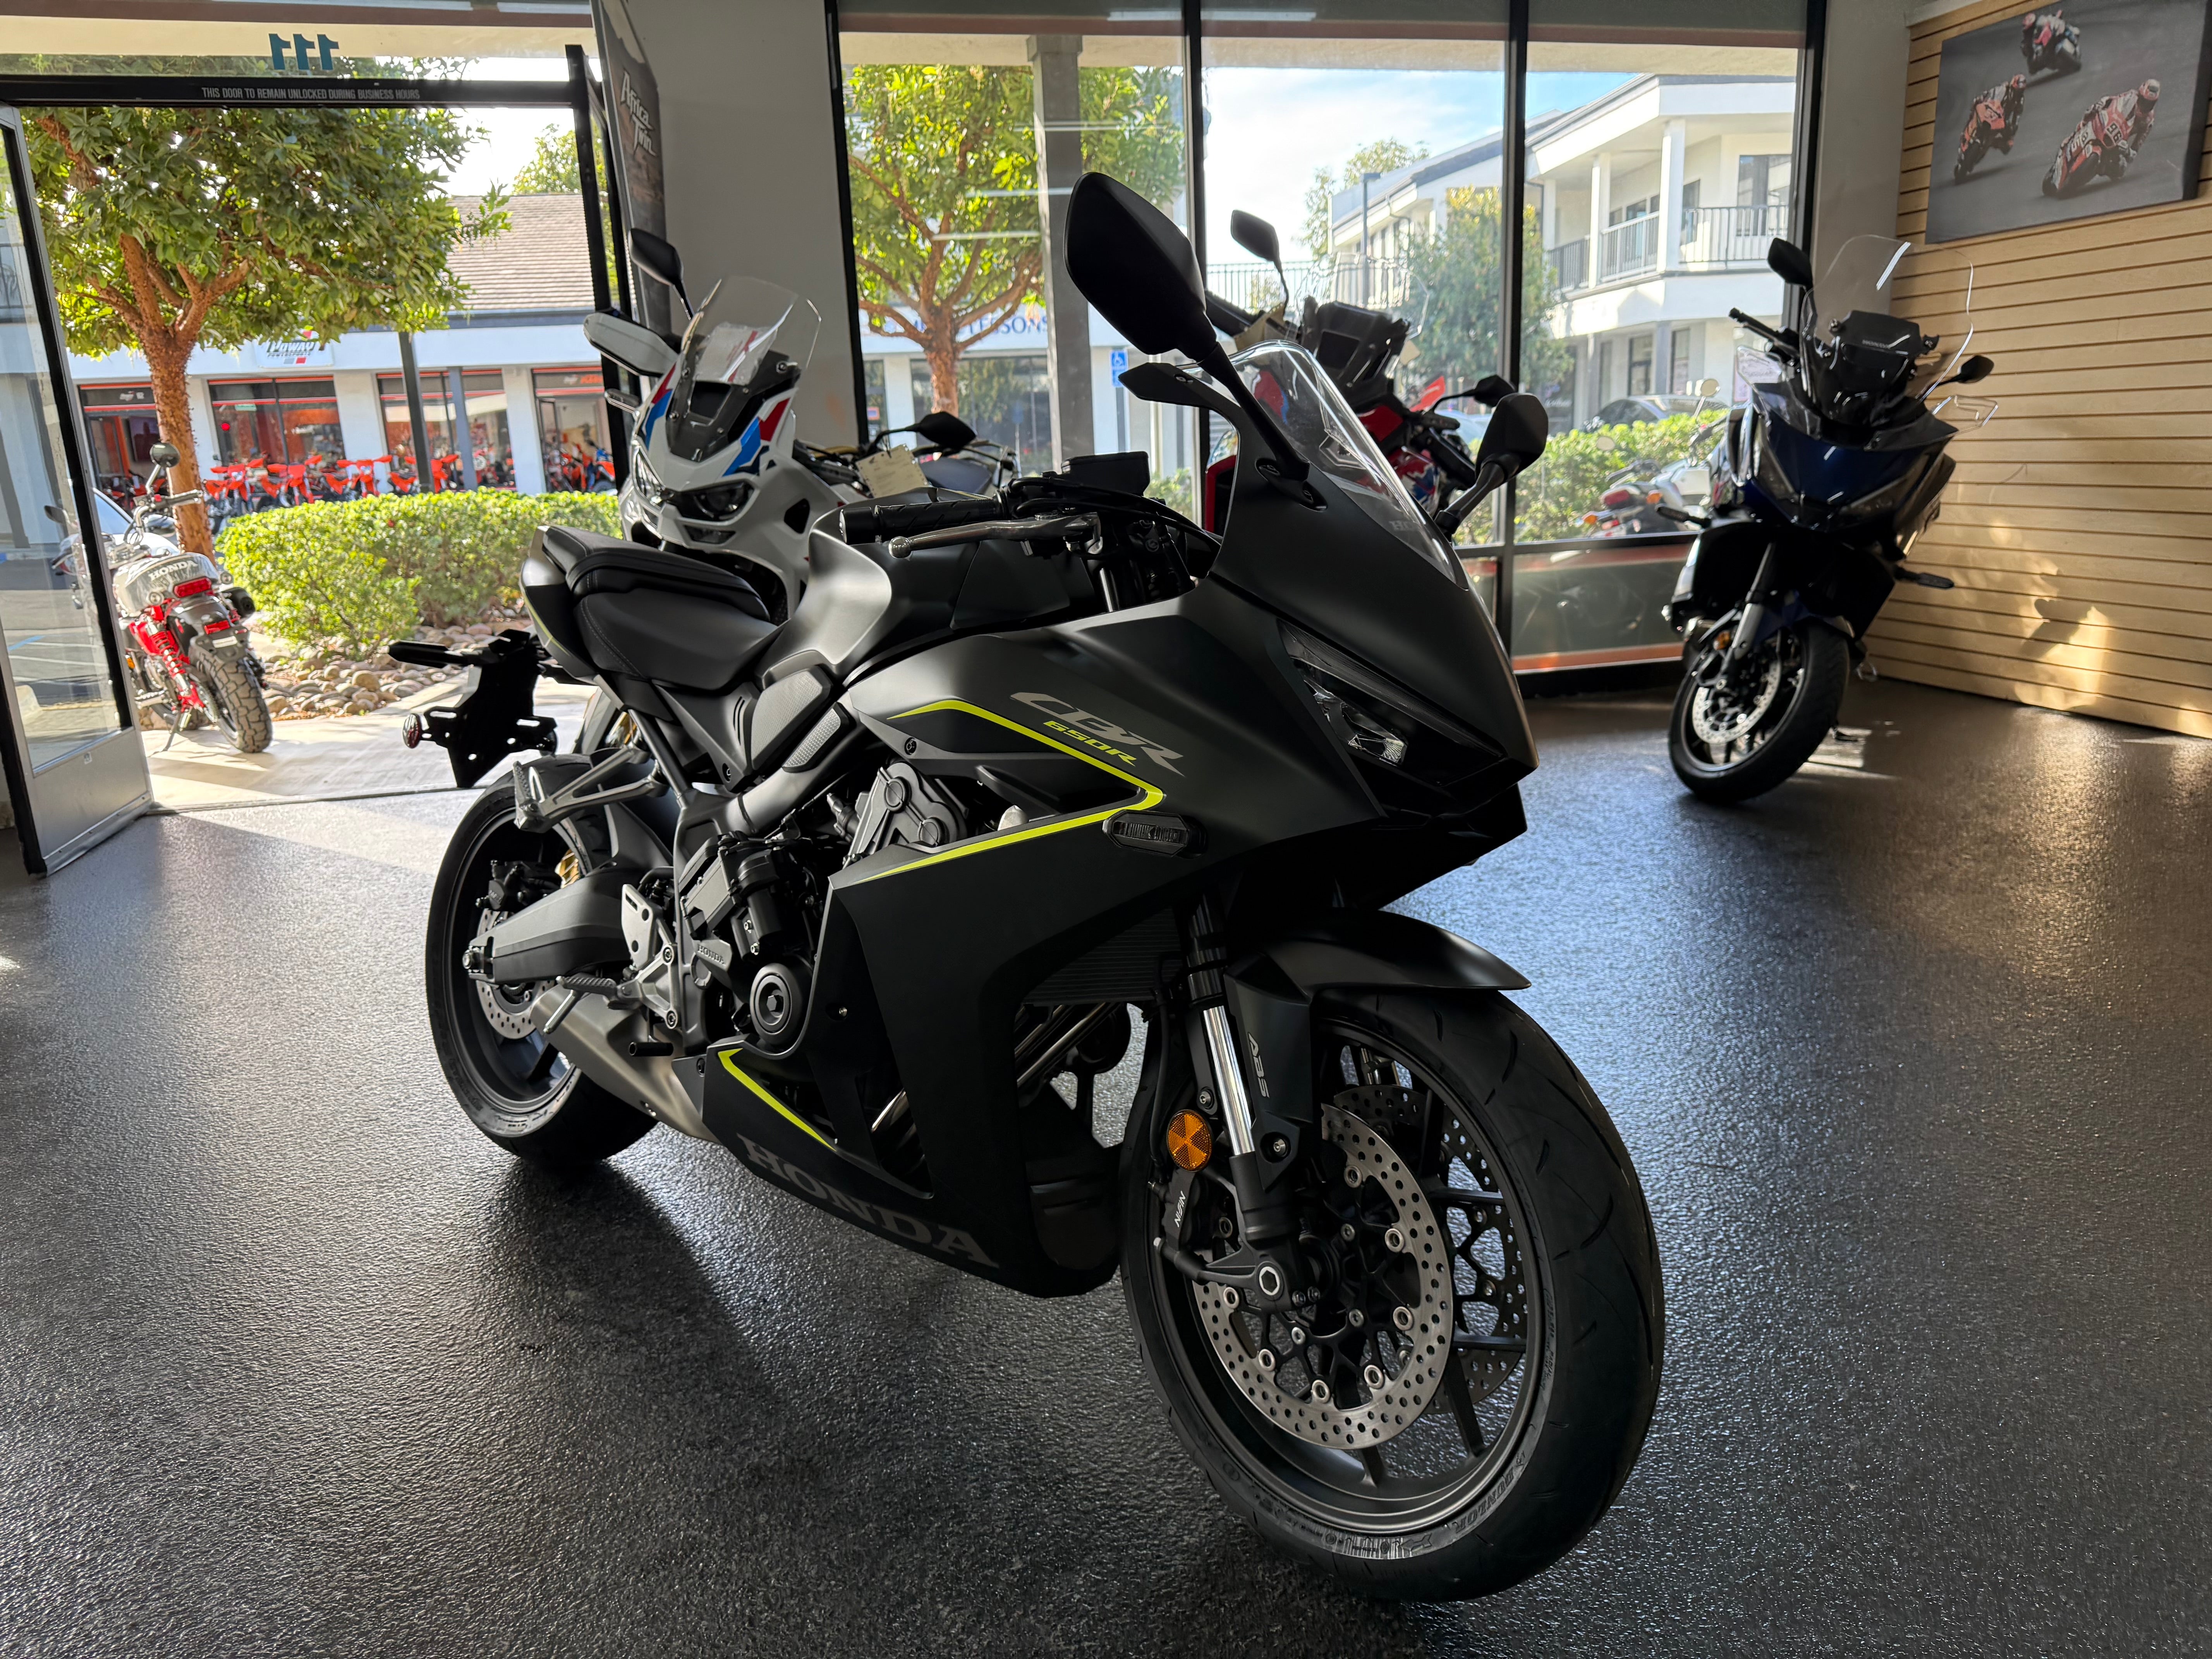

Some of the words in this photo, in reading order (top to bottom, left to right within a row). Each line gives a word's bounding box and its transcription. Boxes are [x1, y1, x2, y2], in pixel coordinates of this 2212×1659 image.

[202, 87, 220, 98] THIS
[223, 88, 243, 99] DOOR
[244, 88, 256, 99] TO
[257, 88, 286, 99] REMAIN
[288, 88, 327, 99] UNLOCKED
[329, 89, 356, 100] DURING
[358, 89, 394, 100] BUSINESS
[396, 89, 420, 100] HOURS
[621, 70, 654, 130] Africa
[632, 113, 657, 156] Twin
[148, 560, 198, 581] HONDA
[1010, 692, 1185, 777] CBR
[1043, 721, 1137, 766] 650R
[697, 944, 726, 966] HONDA
[1248, 1032, 1270, 1098] ABS
[737, 1132, 999, 1269] HONDA
[1175, 1190, 1186, 1228] NISSIN
[1452, 1467, 1514, 1534] DUNLOP
